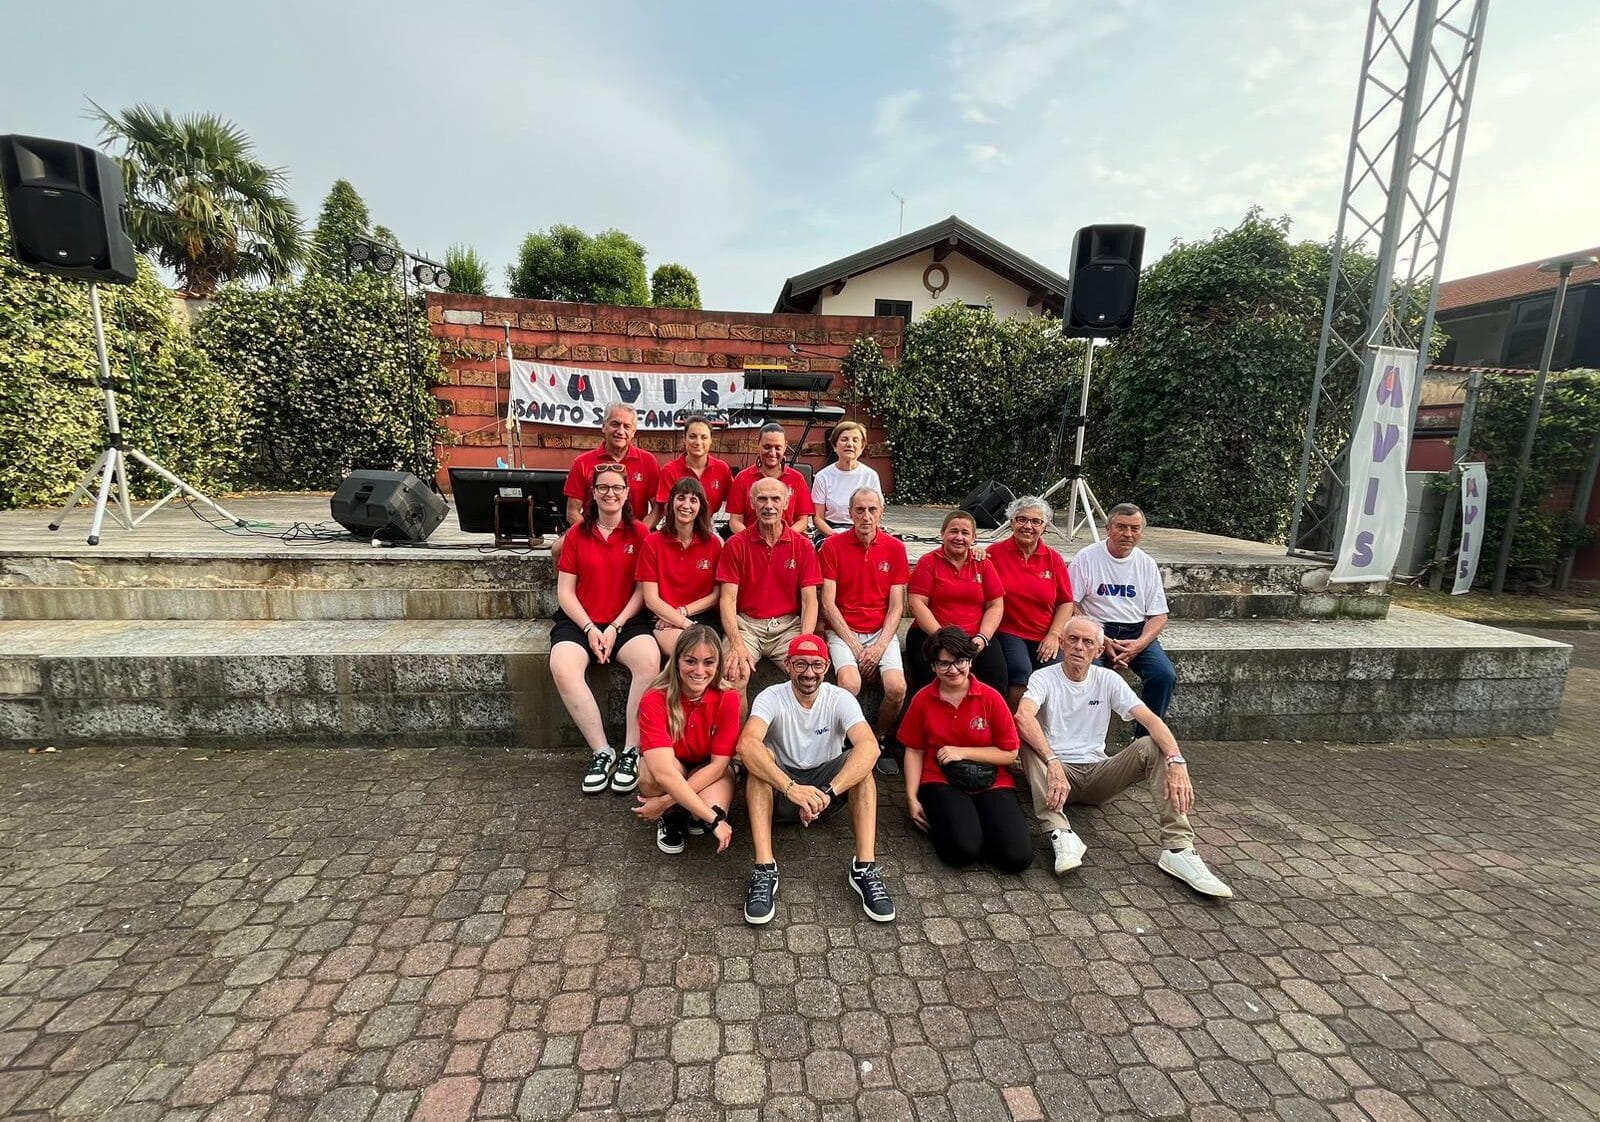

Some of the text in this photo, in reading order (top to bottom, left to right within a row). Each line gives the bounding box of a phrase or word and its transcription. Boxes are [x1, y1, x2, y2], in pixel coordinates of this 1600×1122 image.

[567, 374, 719, 407] AVIS
[513, 399, 584, 424] SANTO
[593, 409, 690, 428] SFANO
[1351, 366, 1403, 568] AVIS
[1459, 478, 1478, 578] AVIS
[1097, 584, 1136, 598] AVIS
